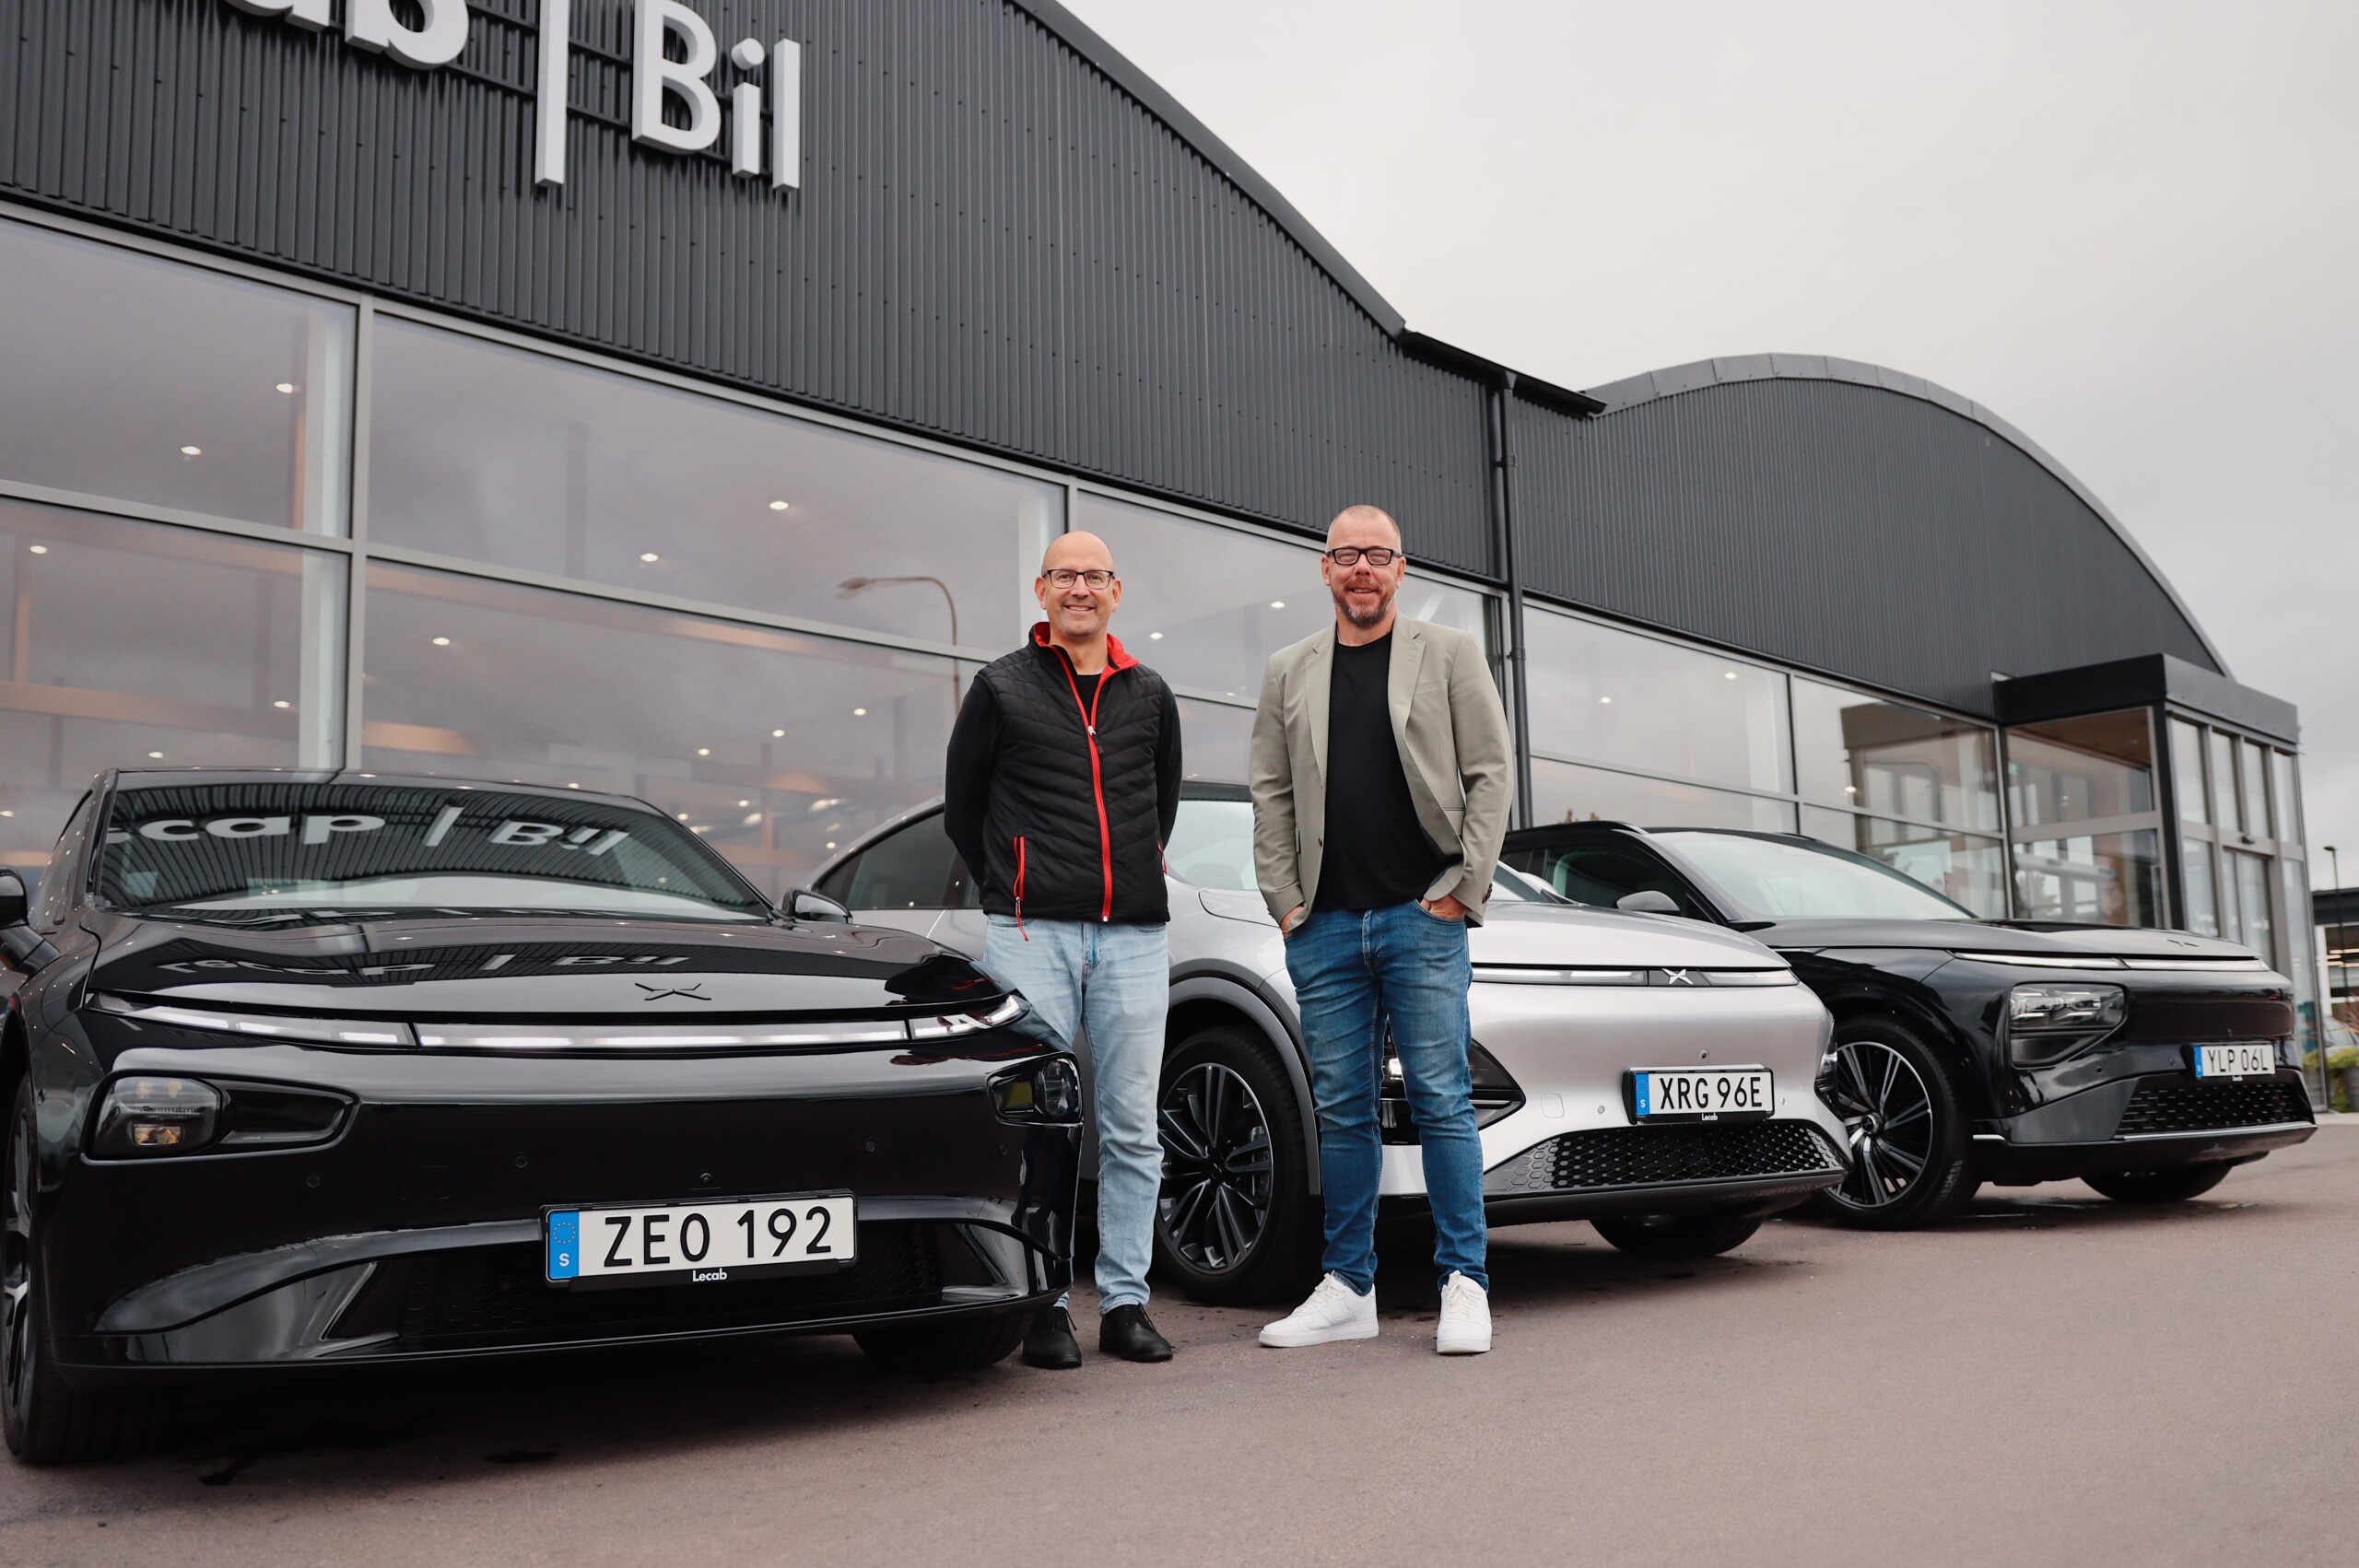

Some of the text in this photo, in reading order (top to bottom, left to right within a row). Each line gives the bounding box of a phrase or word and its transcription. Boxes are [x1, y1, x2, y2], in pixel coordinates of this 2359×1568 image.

[632, 0, 801, 193] Bil
[2208, 1048, 2268, 1072] YLP 06L
[1640, 1099, 1646, 1107] S
[1660, 1076, 1763, 1109] XRG 96E
[604, 1206, 832, 1268] ZEO 192
[558, 1252, 570, 1267] S
[692, 1267, 728, 1281] Lecab
